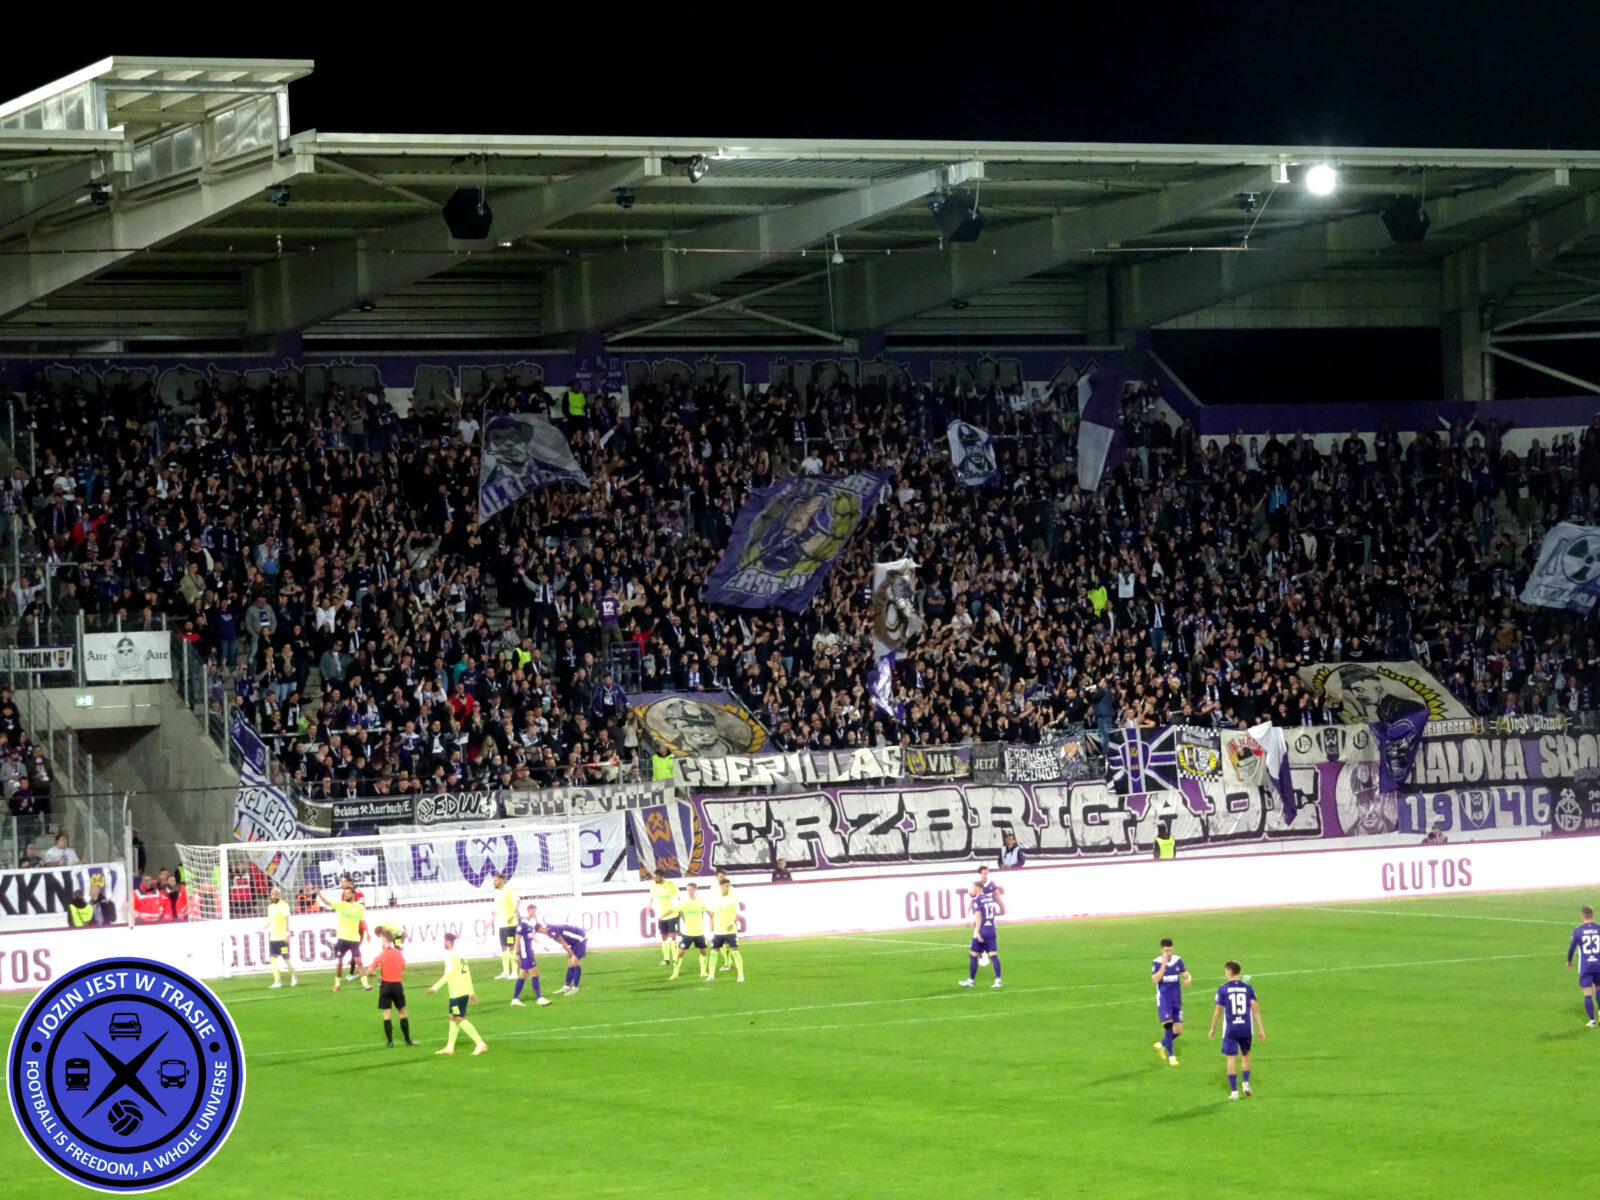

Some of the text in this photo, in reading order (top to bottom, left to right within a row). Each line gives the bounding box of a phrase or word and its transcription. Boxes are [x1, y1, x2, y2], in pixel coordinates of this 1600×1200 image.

[602, 601, 614, 612] 12
[87, 649, 169, 661] Aue Aue
[676, 746, 905, 788] GUERILLAS
[927, 754, 951, 773] VM
[974, 758, 999, 769] JETZT
[1381, 858, 1472, 891] GLUTOS
[905, 886, 1006, 922] GLUT
[984, 902, 994, 919] 13
[1582, 935, 1600, 954] 23
[1228, 993, 1246, 1015] 19
